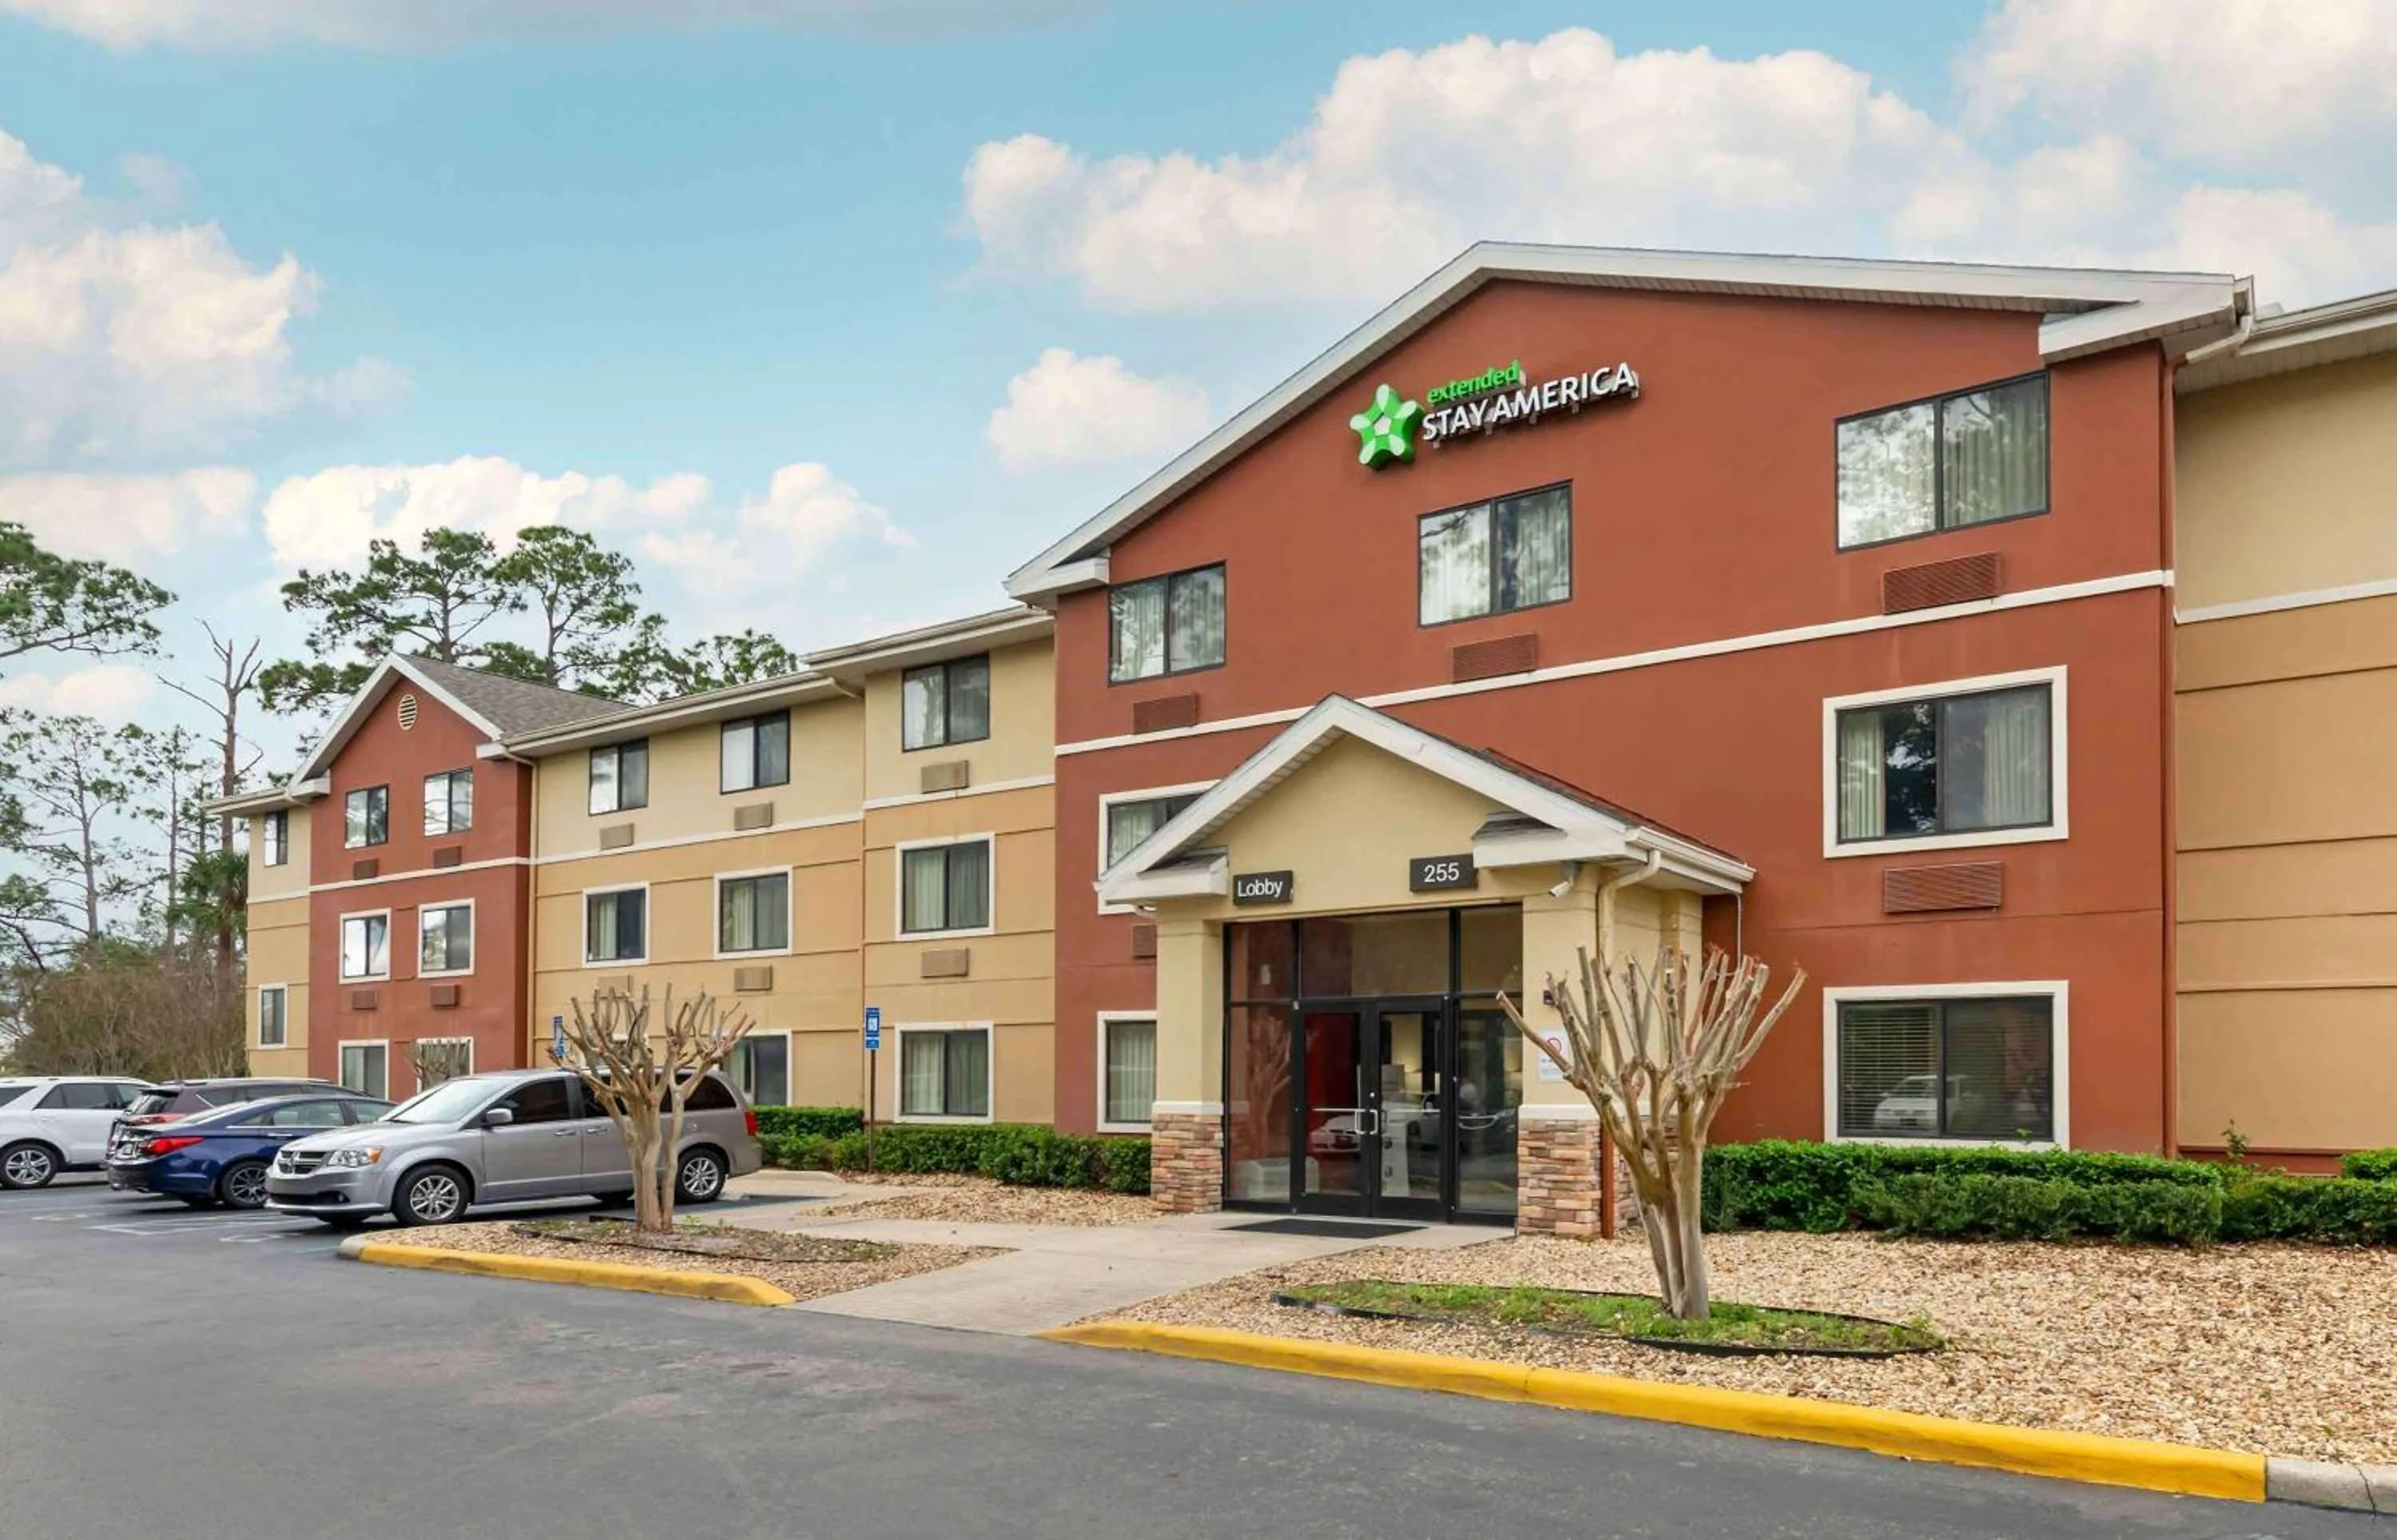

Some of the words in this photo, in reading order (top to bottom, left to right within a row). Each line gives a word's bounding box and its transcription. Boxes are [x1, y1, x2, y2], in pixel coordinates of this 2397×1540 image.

[1426, 359, 1520, 403] extended
[1424, 862, 1460, 883] 255
[1238, 878, 1283, 899] Lobby
